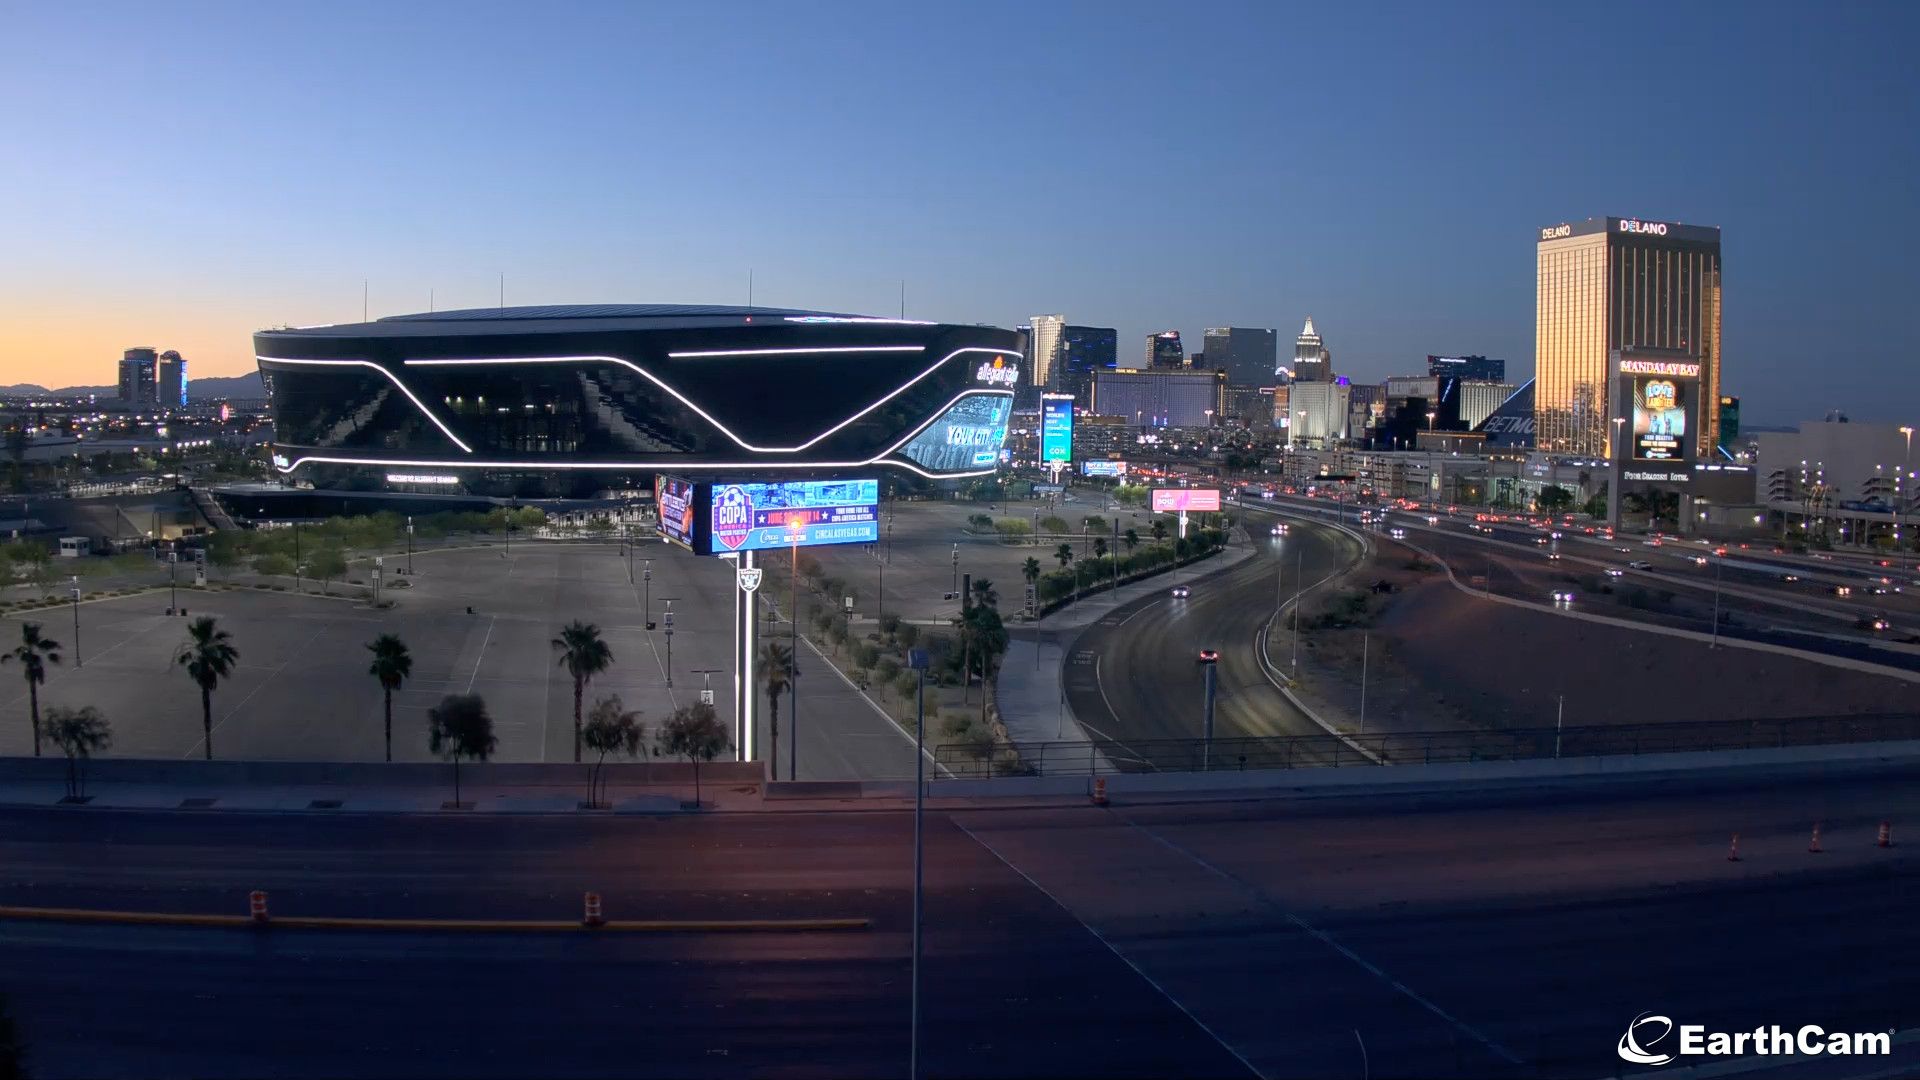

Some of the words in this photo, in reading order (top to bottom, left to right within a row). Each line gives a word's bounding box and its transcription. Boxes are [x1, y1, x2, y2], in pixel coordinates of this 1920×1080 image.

[1542, 224, 1571, 239] DELANO
[1620, 219, 1667, 236] DELANO
[1620, 360, 1679, 375] MANDALAY
[1680, 364, 1700, 376] BAY
[1648, 385, 1673, 398] LOVE
[946, 425, 976, 446] YOUR
[1049, 447, 1067, 455] COX
[719, 506, 747, 524] COPA
[719, 523, 748, 531] AMERICA
[815, 527, 871, 539] CIRCALASVEGAS.COM
